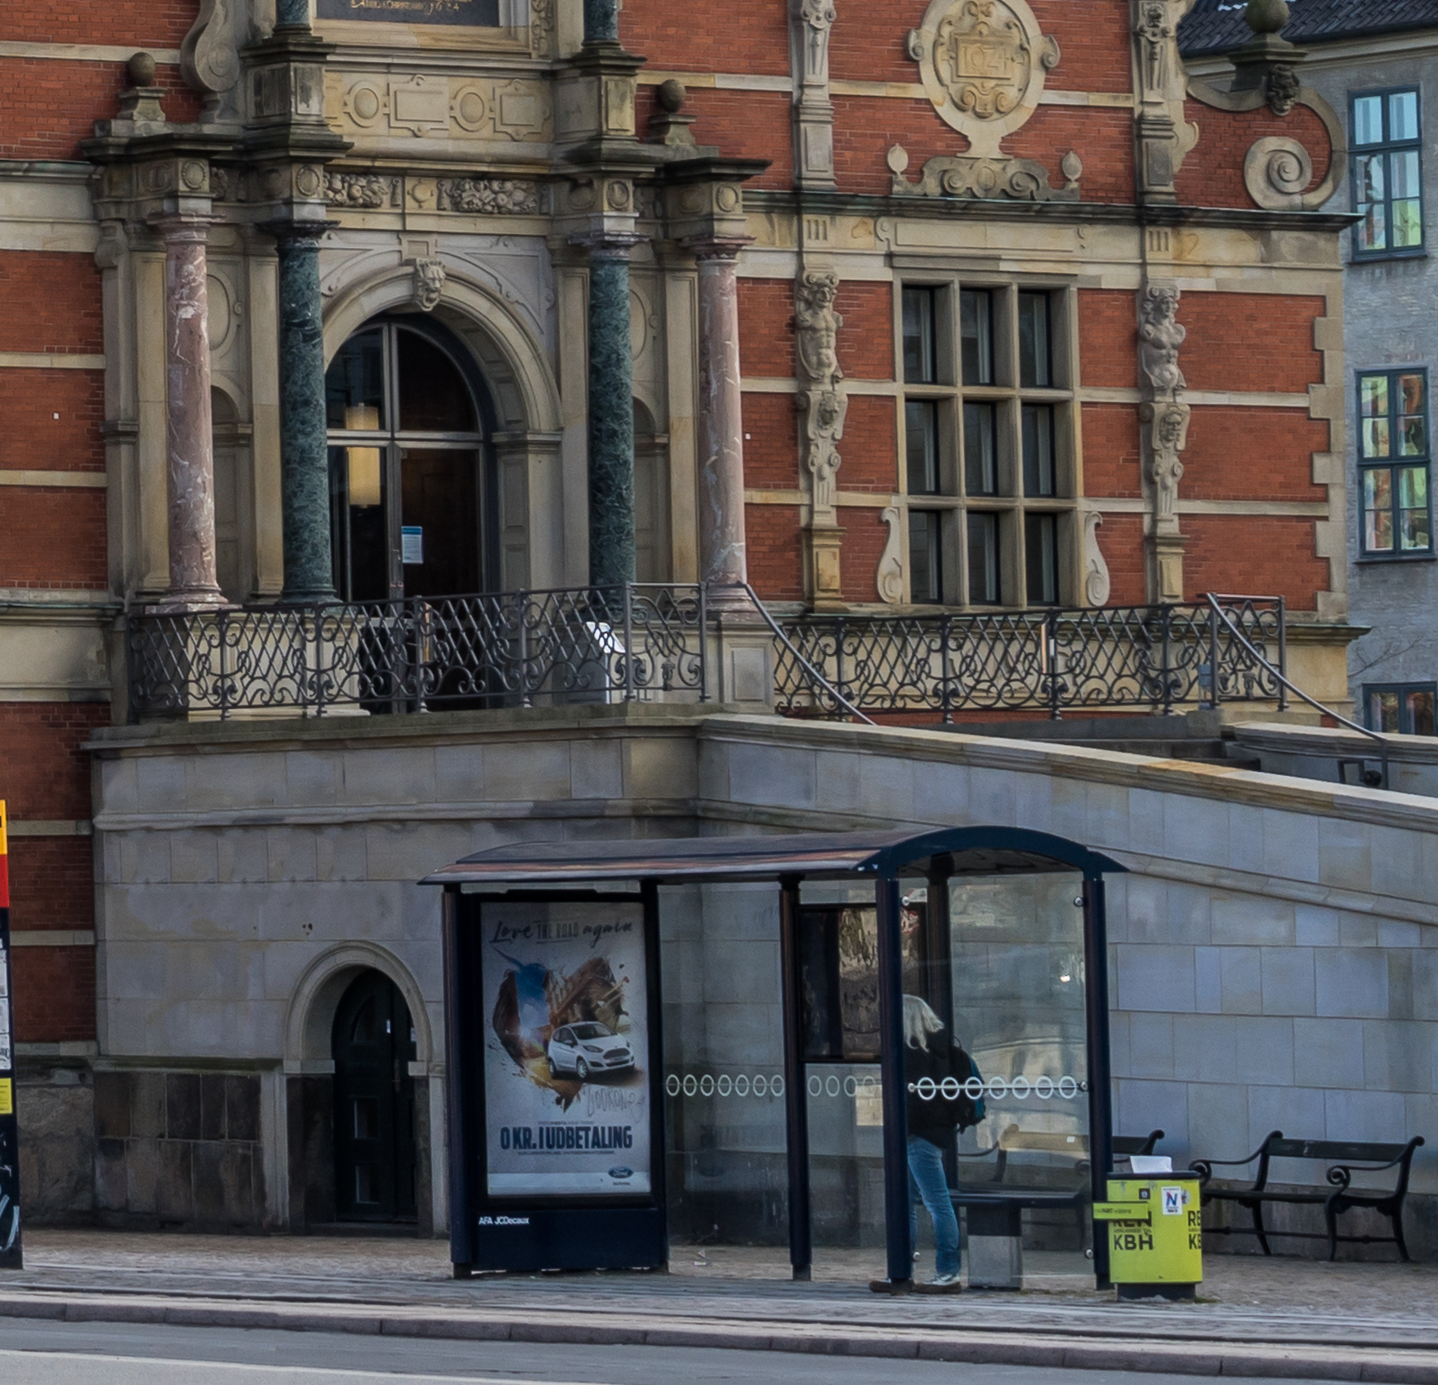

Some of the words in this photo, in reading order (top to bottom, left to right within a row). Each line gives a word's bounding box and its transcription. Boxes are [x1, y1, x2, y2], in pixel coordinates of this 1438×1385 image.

[489, 921, 534, 944] Love
[537, 923, 552, 939] THE
[556, 922, 579, 938] ROAD
[583, 919, 632, 948] again
[513, 1126, 537, 1150] KR.
[545, 1125, 633, 1149] UDBETALING
[494, 1216, 530, 1225] JCDecaux
[1113, 1234, 1154, 1250] KBH
